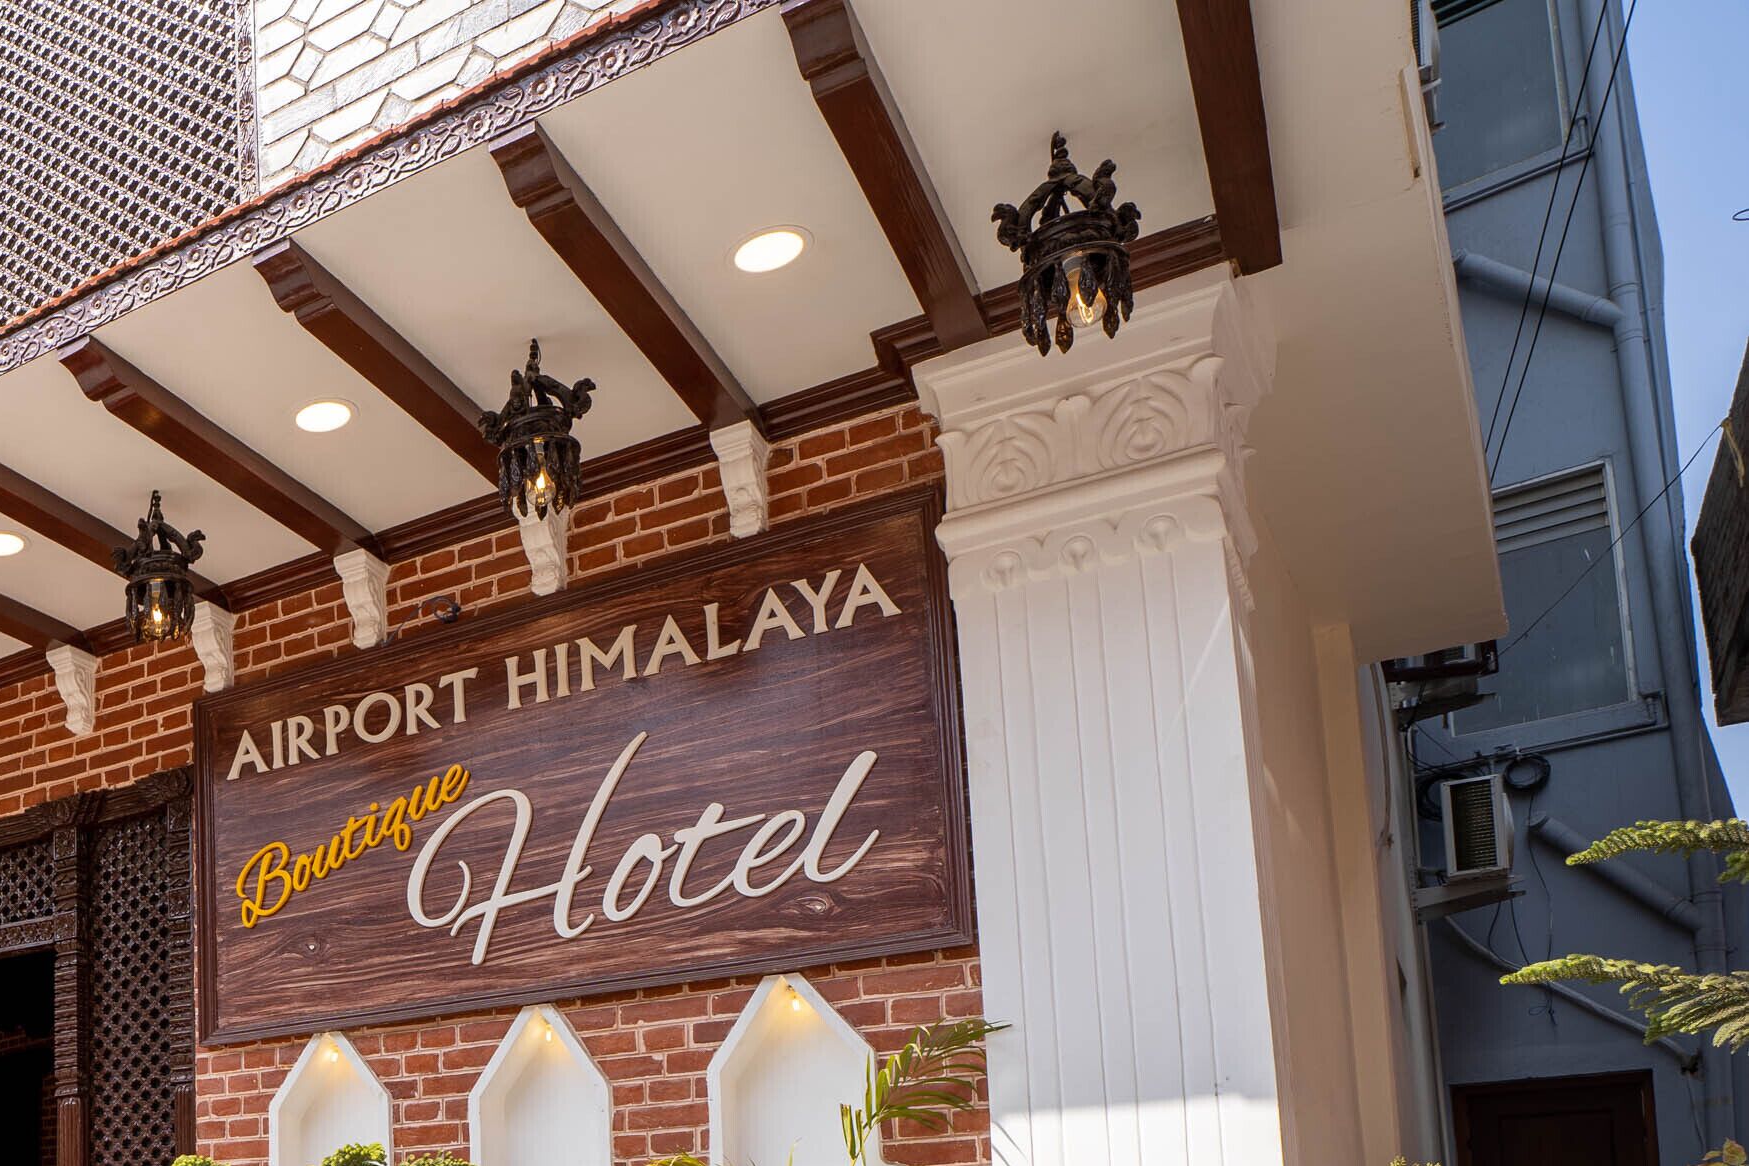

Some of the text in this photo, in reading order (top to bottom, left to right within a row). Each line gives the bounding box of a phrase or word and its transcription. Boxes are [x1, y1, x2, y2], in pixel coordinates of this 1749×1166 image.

[226, 563, 902, 781] AIRPORT HIMALAYA
[235, 763, 470, 929] Boutique
[407, 731, 880, 965] Hotel
